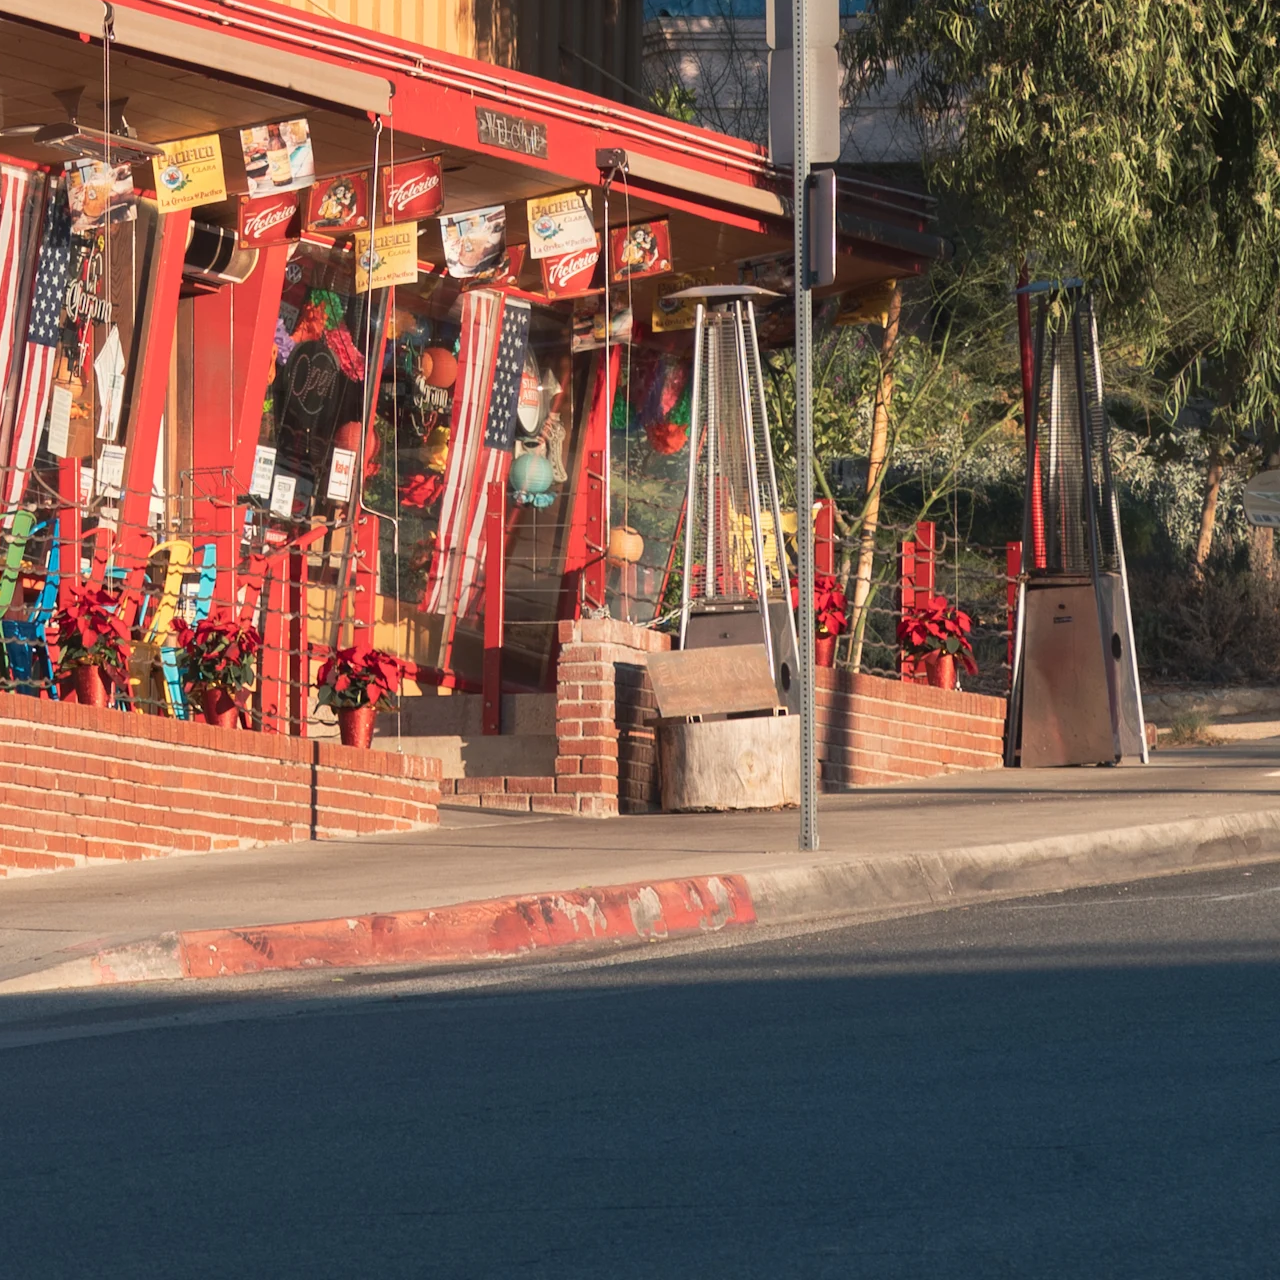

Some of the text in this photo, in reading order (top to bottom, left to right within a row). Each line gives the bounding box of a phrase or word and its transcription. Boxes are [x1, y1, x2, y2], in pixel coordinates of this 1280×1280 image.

[485, 111, 541, 155] WELCOME
[388, 172, 440, 211] Victoria
[244, 202, 296, 238] Victoria
[549, 250, 599, 288] Victoria
